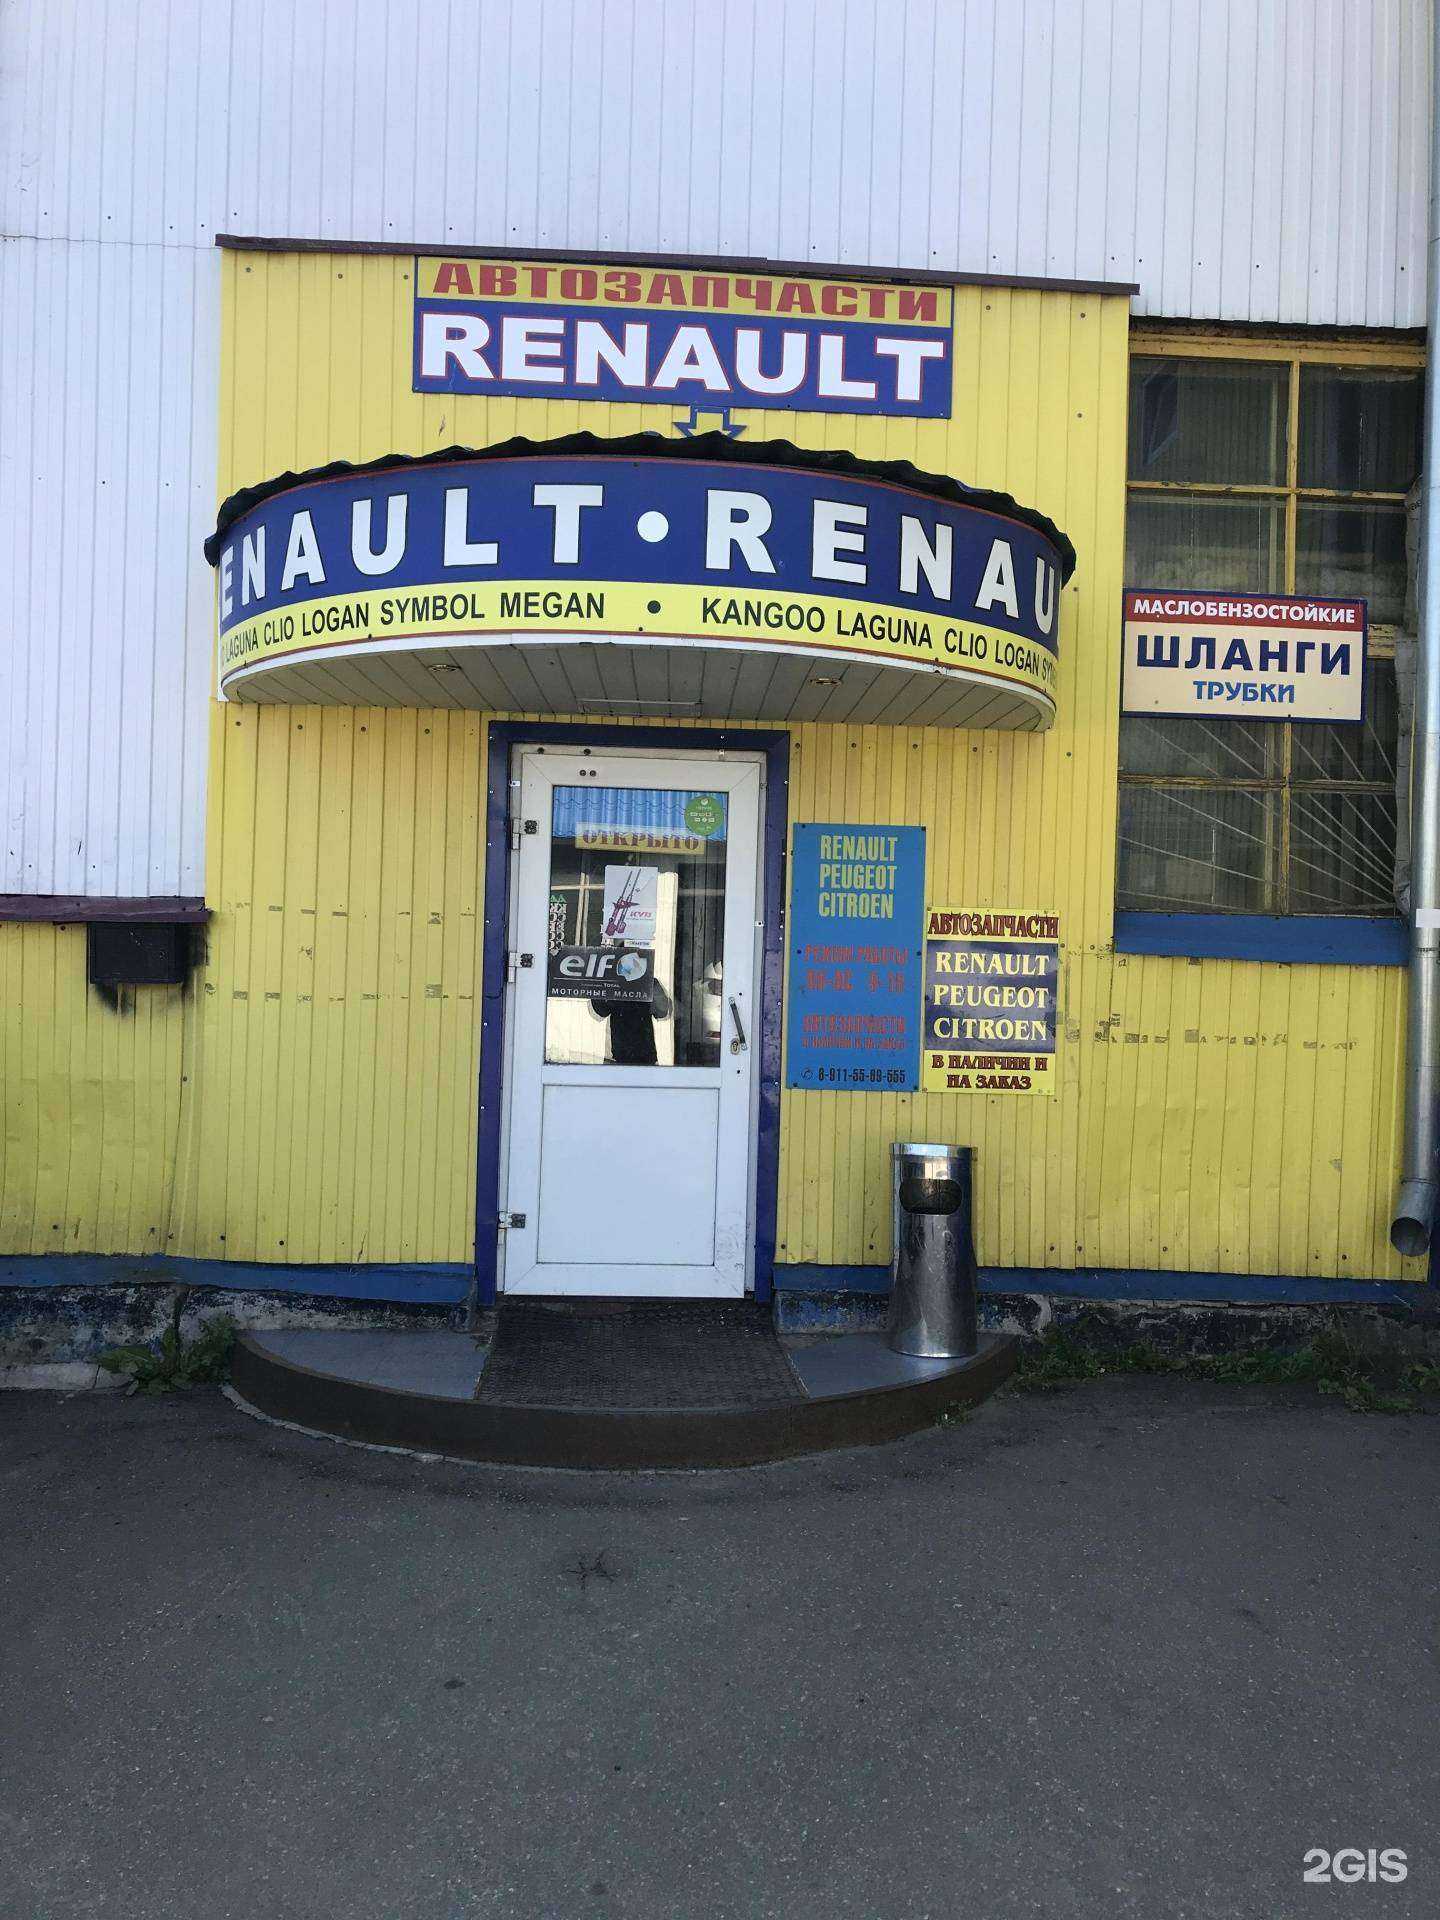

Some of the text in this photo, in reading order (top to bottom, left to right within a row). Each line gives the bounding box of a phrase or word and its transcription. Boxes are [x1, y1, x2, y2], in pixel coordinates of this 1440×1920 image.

[433, 261, 938, 322] АВТОЗАПЧАСТИ
[420, 312, 946, 402] RENAULT
[704, 488, 1055, 635] RENAU
[1133, 598, 1356, 625] МАСЛОБЕНЗОСТОЙКИЕ
[264, 616, 294, 646] CLIO
[302, 602, 369, 636] LOGAN
[380, 593, 485, 626] SYMBOL
[500, 592, 605, 619] MEGAN
[702, 597, 826, 633] KANGOO
[837, 609, 933, 650] LAGUNA
[944, 628, 988, 660] CLIO
[995, 640, 1040, 677] LOGAN
[1136, 634, 1351, 676] ШЛАНГИ
[1192, 680, 1296, 704] ТРУБКИ
[820, 834, 898, 862] RENAULT
[819, 864, 898, 890] PEUGEOT
[818, 892, 894, 919] CITROEN
[927, 912, 1060, 939] АВТОЗАПЧАСТИ
[559, 953, 616, 978] elf
[935, 951, 1050, 977] RENAULT
[551, 987, 648, 998] МОТОРНЫЕ МАСЛА
[933, 983, 1049, 1009] PEUGEOT
[933, 1016, 1048, 1042] CITROEN
[931, 1054, 1049, 1072] В НАЛИЧИИ И
[946, 1073, 1033, 1091] НА ЗАКАЗ
